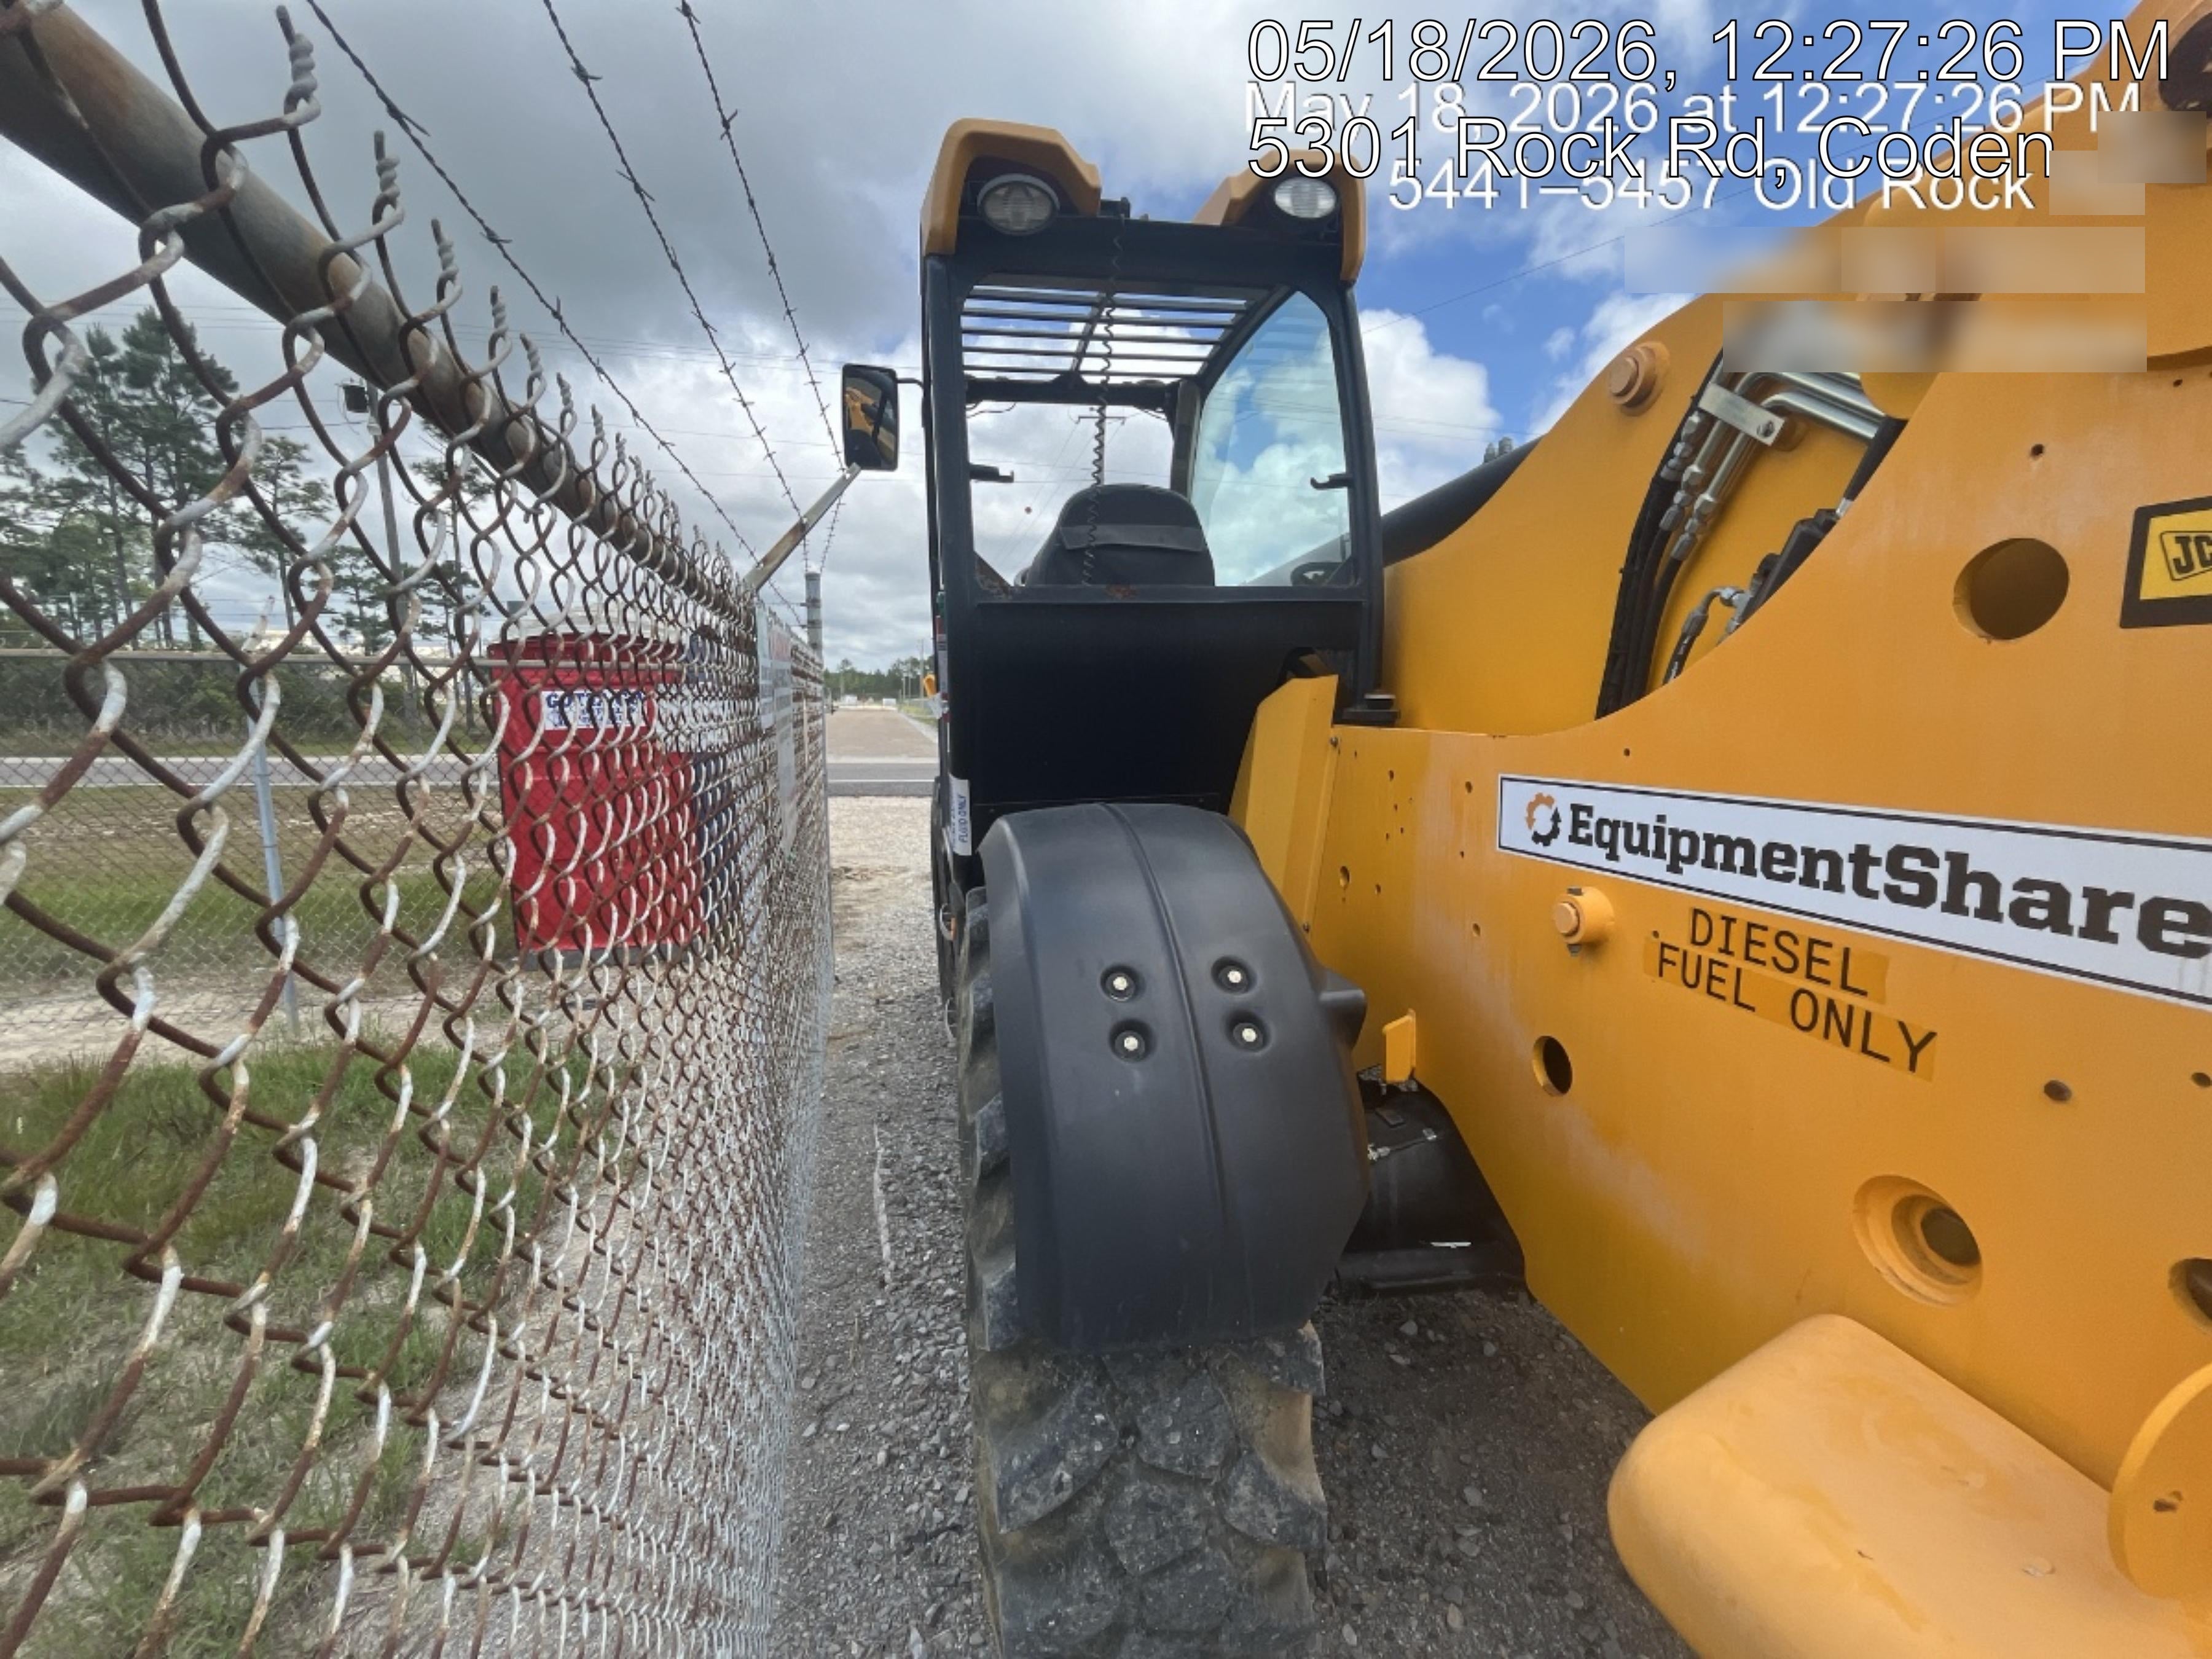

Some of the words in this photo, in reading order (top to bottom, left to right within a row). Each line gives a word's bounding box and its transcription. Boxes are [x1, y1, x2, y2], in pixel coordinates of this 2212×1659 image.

[2172, 535, 2212, 575] JC
[1568, 802, 2212, 959] EquipmentShare
[1658, 941, 1755, 1013] FUEL
[1790, 987, 1937, 1073] ONLY
[1690, 908, 1868, 997] DIESEL
